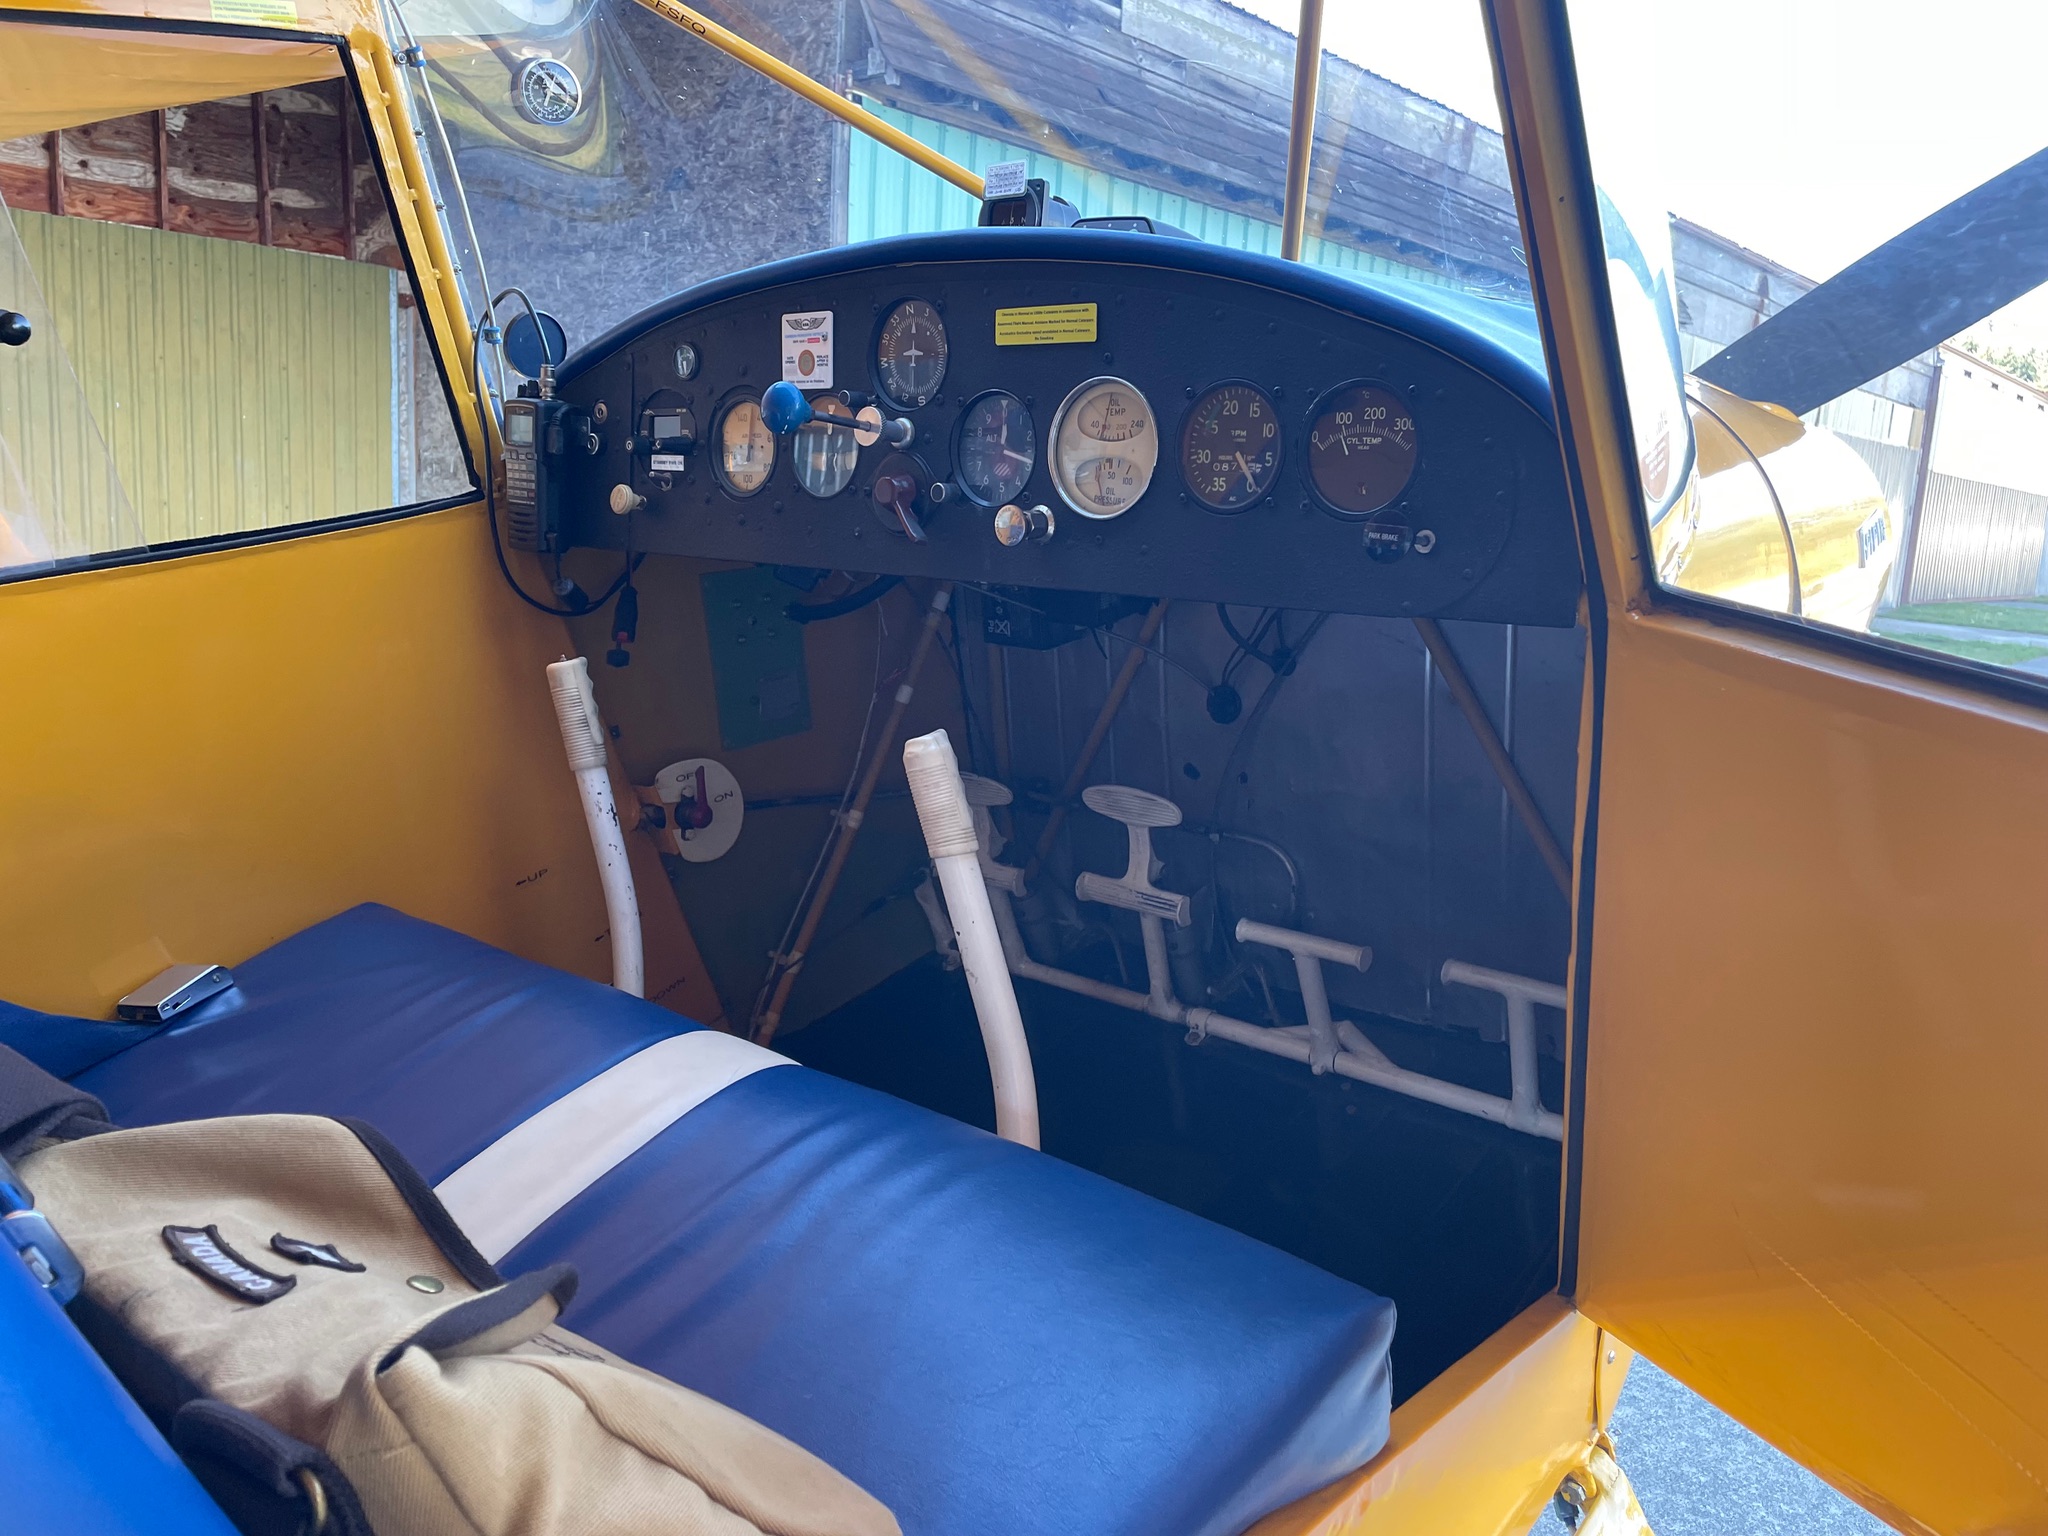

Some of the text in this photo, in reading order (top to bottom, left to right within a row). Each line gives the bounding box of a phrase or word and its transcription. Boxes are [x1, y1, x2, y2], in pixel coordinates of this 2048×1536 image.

[905, 304, 929, 317] N 3
[891, 315, 900, 327] 33
[882, 333, 890, 346] 30
[917, 396, 926, 406] S
[1110, 398, 1120, 407] OIL
[1106, 408, 1126, 417] TEMP
[1223, 400, 1260, 418] 20 15
[986, 414, 992, 425] 9
[1336, 412, 1353, 424] 100
[1364, 407, 1386, 420] 200
[1090, 420, 1100, 428] 40
[1131, 420, 1144, 428] 240
[977, 427, 1033, 441] 8 2
[1263, 423, 1274, 438] 10
[985, 434, 998, 442] ALT
[1311, 431, 1319, 443] 0
[1196, 450, 1211, 464] 30
[1265, 452, 1273, 467] 5
[976, 462, 1031, 472] 7 3
[742, 475, 753, 484] 100
[983, 475, 1021, 486] 6 4
[1107, 471, 1116, 480] 50
[1122, 477, 1133, 485] 100
[999, 482, 1005, 493] 5
[1212, 477, 1226, 492] 35
[1105, 487, 1116, 495] OIL
[1368, 532, 1399, 541] PARK BRAKE
[675, 772, 695, 782] OF
[714, 790, 734, 803] ON
[527, 868, 548, 882] UP
[183, 1235, 273, 1290] CANADA
